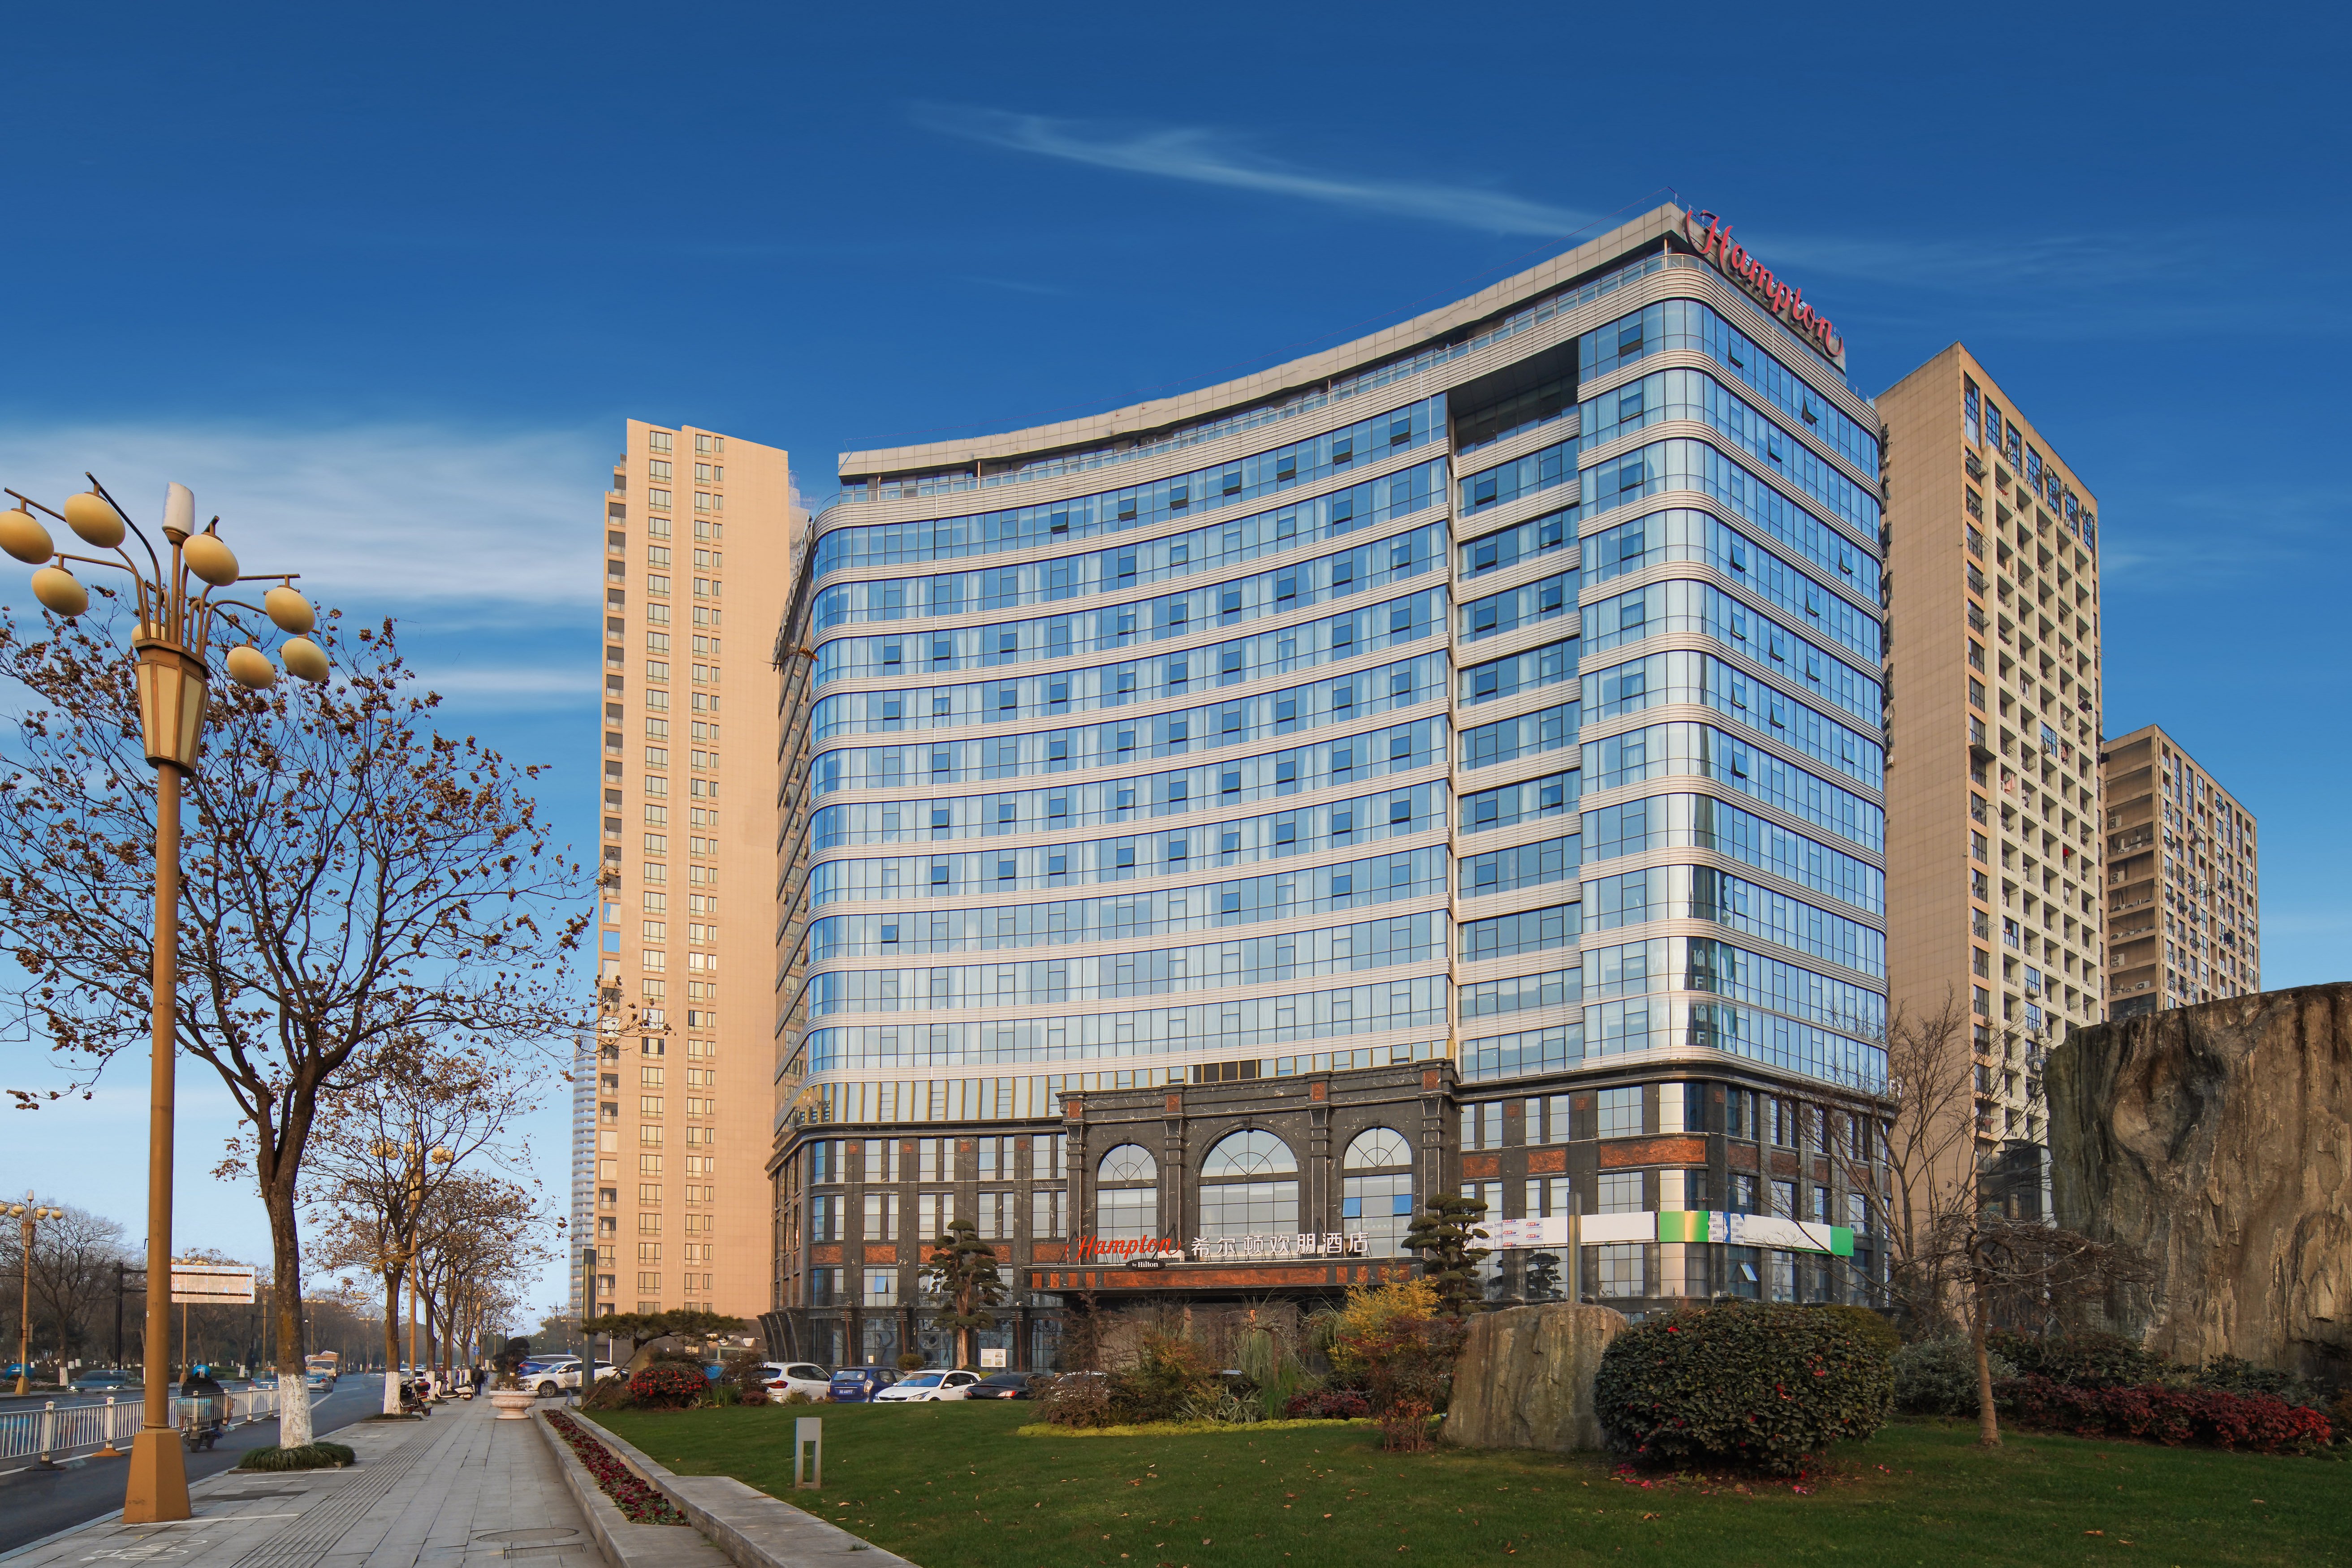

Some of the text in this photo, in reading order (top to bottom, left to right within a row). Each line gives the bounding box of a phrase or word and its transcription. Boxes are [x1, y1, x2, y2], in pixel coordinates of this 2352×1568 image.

[1684, 210, 1844, 357] Hampton
[1065, 1234, 1181, 1262] Hampton
[1191, 1231, 1369, 1257] 希尔顿欢朋酒店
